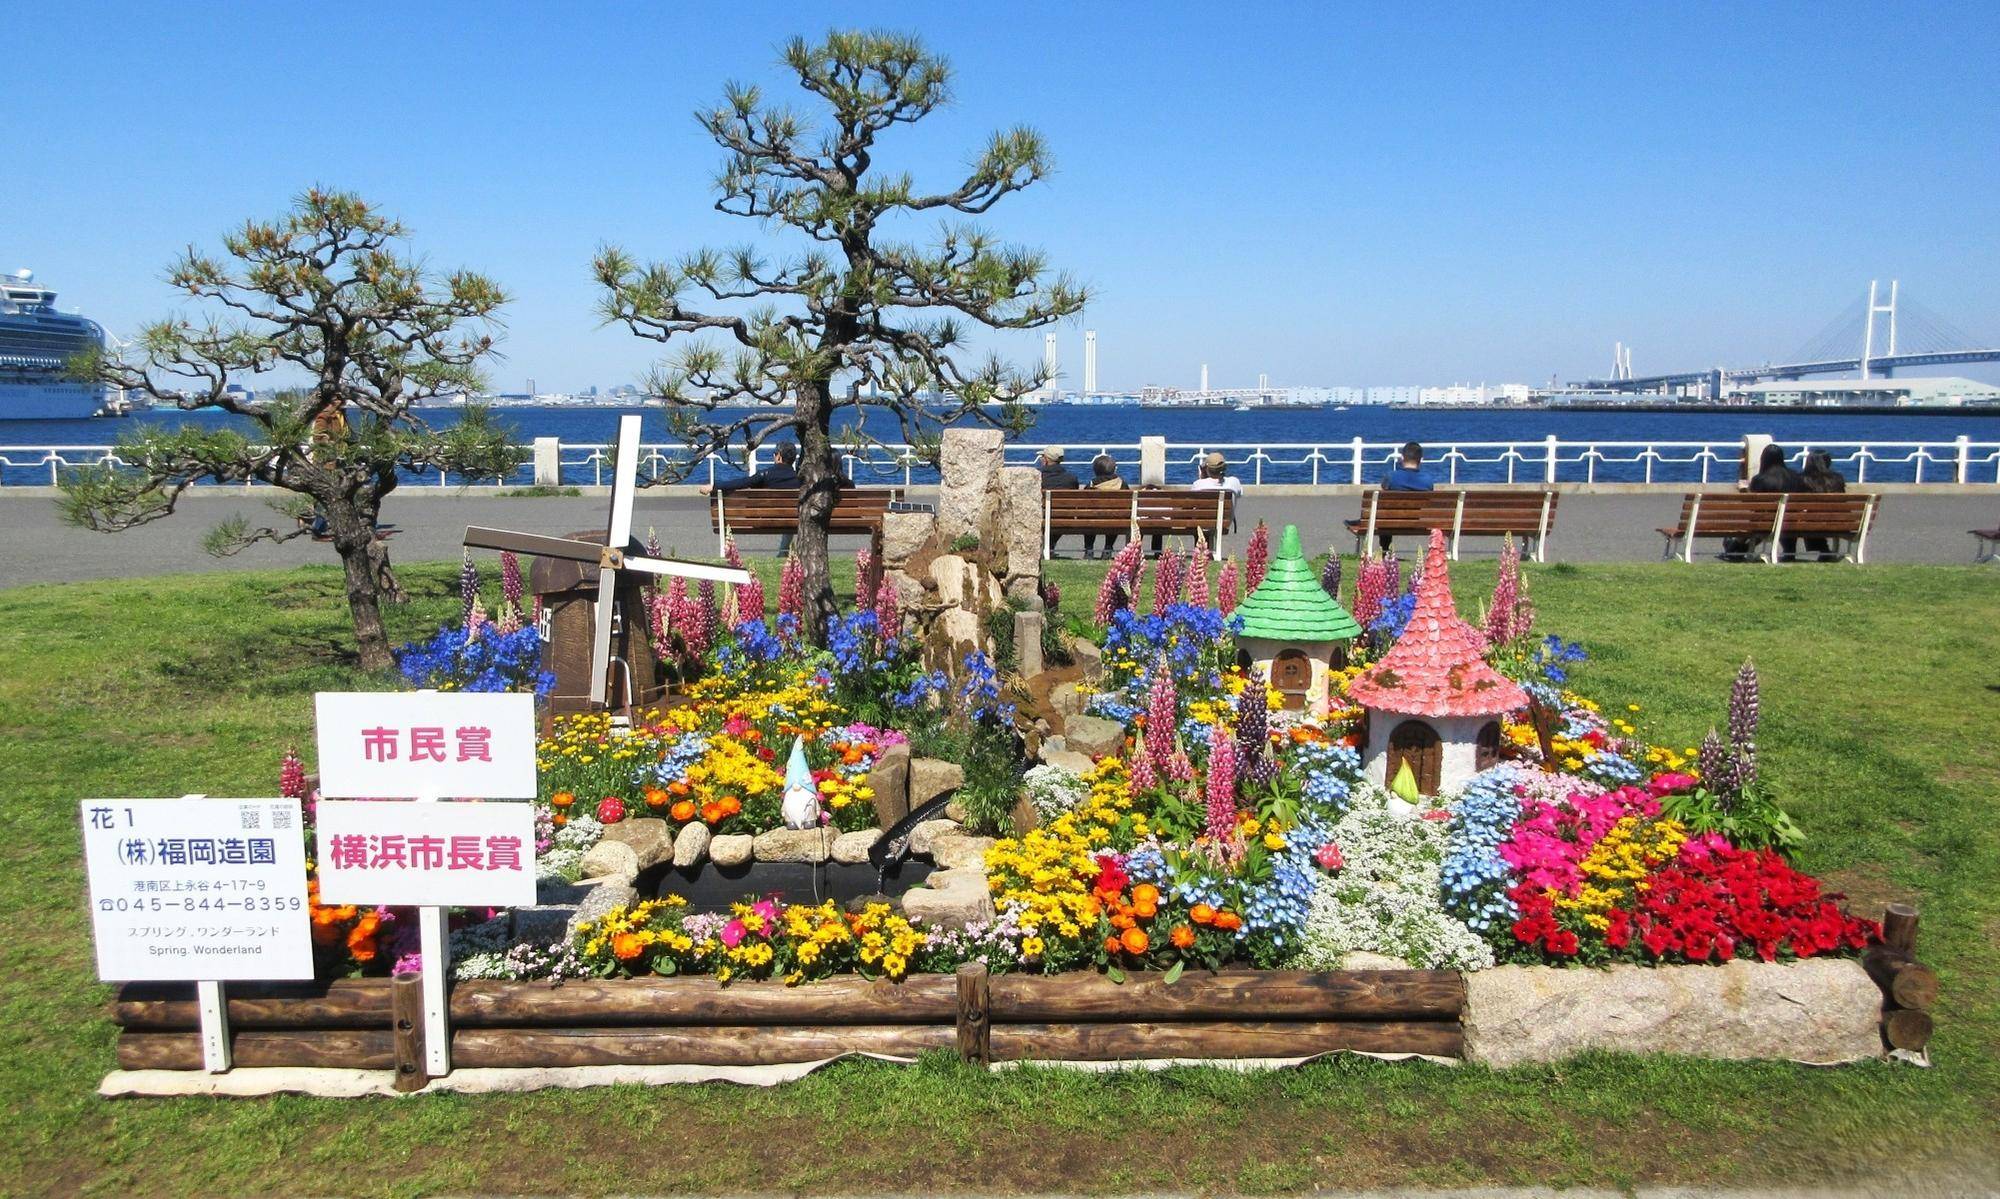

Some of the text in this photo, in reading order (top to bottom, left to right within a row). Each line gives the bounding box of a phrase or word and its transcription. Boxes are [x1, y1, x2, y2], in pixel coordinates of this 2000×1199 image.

[361, 726, 493, 763] 市民賞
[117, 837, 277, 866] (株)福岡造園
[330, 833, 523, 872] 横浜市長賞
[193, 944, 262, 956] Wonderland
